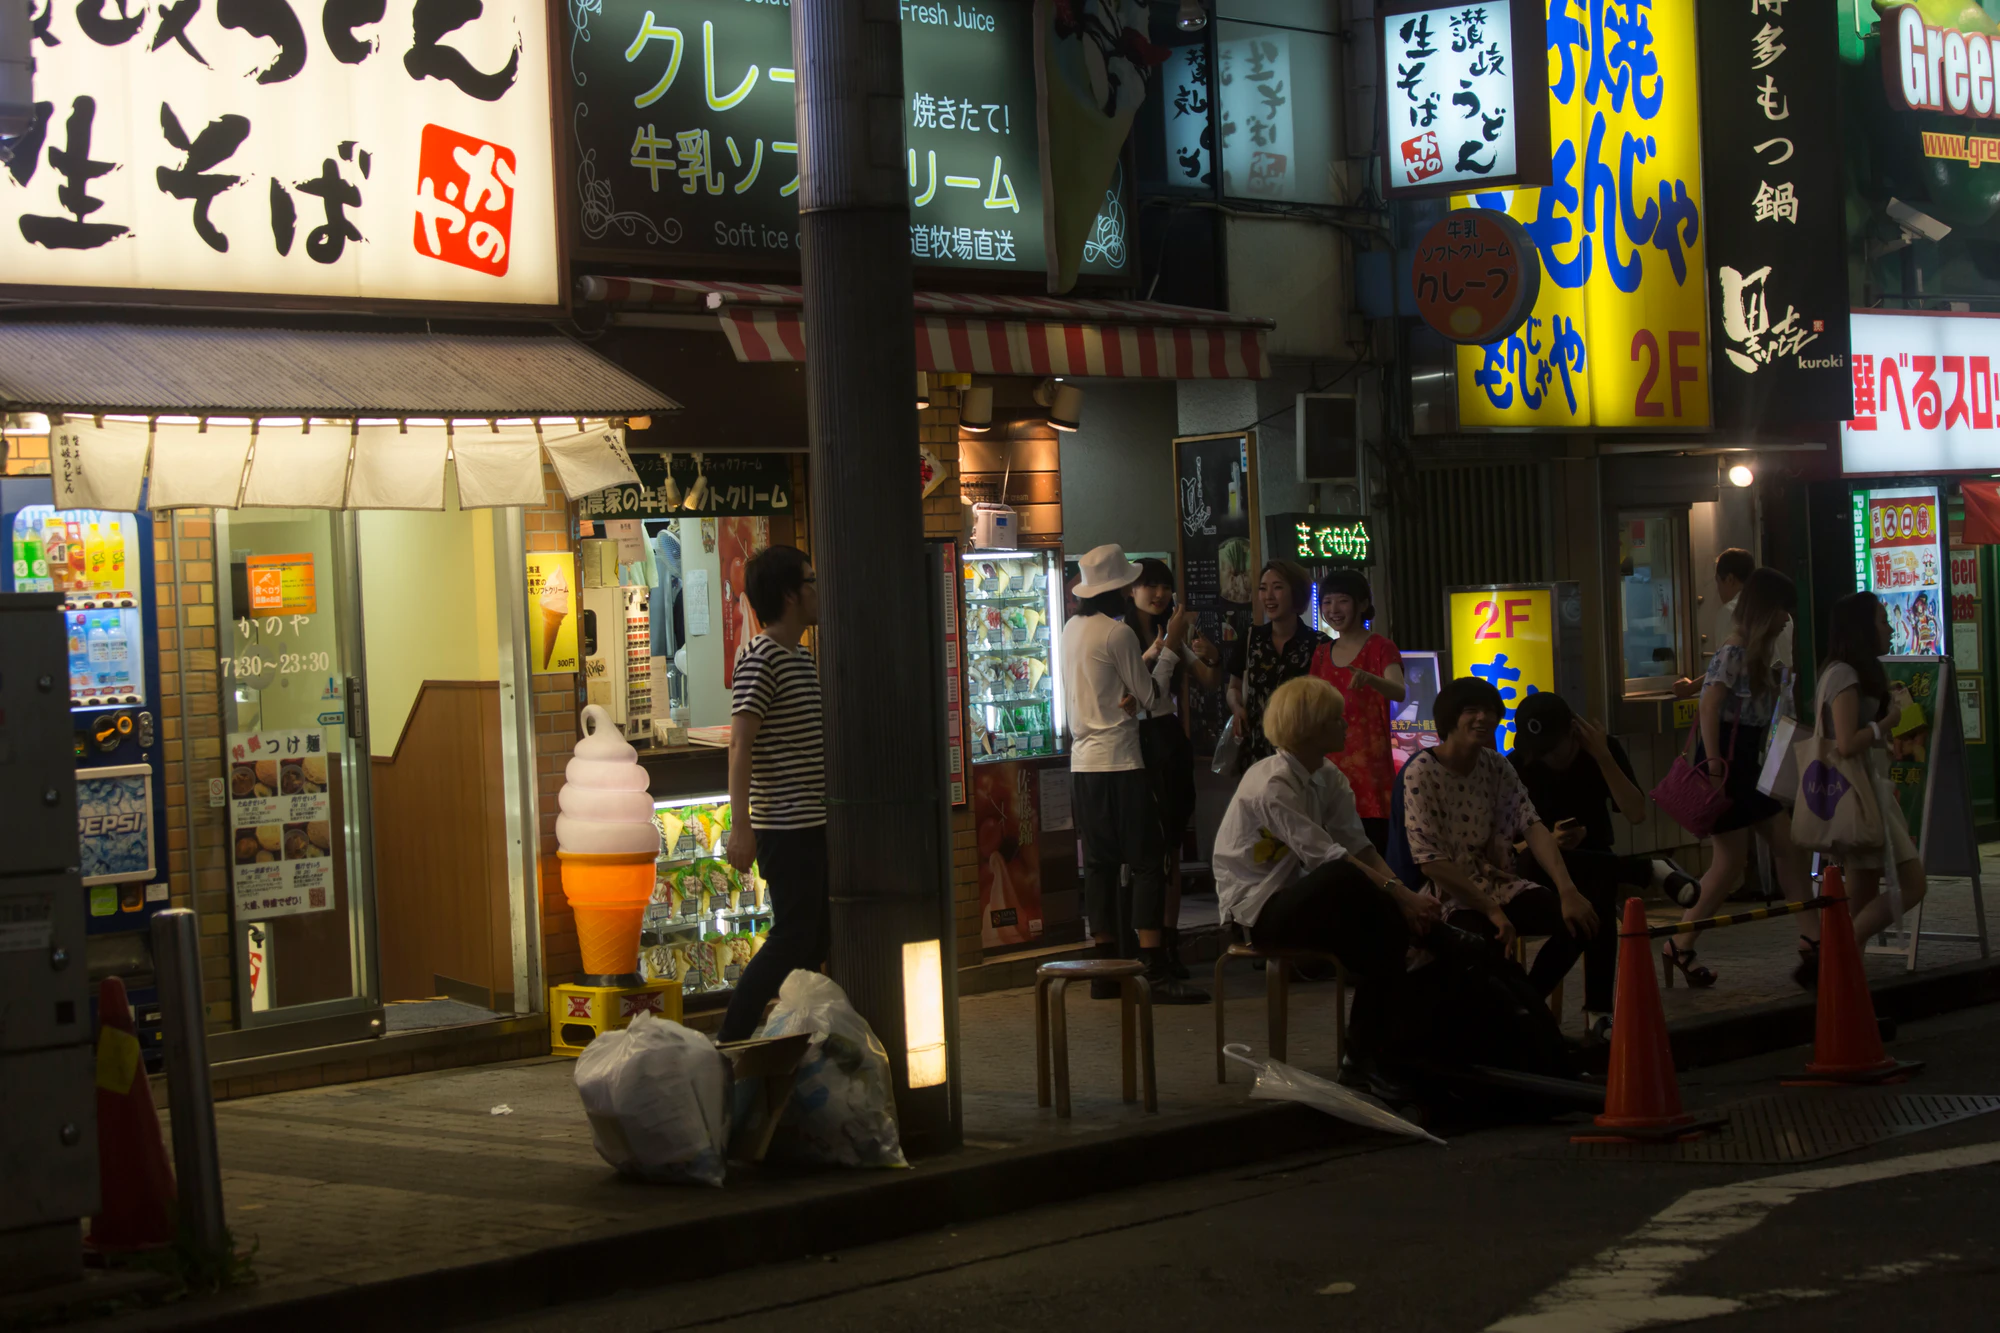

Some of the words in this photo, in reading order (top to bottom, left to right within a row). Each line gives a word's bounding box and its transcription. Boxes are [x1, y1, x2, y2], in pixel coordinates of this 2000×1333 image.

[900, 0, 949, 27] Fresh
[953, 4, 996, 33] Juice
[624, 9, 797, 112] クレー
[1396, 14, 1440, 127] 生そば
[1449, 8, 1507, 174] 讃岐うどん
[1923, 134, 2000, 166] www.gre
[1522, 110, 1700, 294] もんじゃ
[714, 220, 755, 248] Soft
[760, 223, 790, 250] ice
[910, 224, 1017, 263] 道牧場直送
[1447, 219, 1488, 239] 牛乳
[1421, 241, 1521, 263] ソフトクリーム
[1417, 265, 1527, 303] クレープ
[1630, 328, 1700, 418] 2F
[1798, 354, 1843, 369] kuroki
[1295, 520, 1371, 560] まで60分
[238, 614, 310, 639] かのや
[1474, 599, 1533, 640] 2F
[556, 657, 576, 669] 300円
[1017, 768, 1034, 847] 佐藤錦
[1807, 780, 1844, 797] NADA
